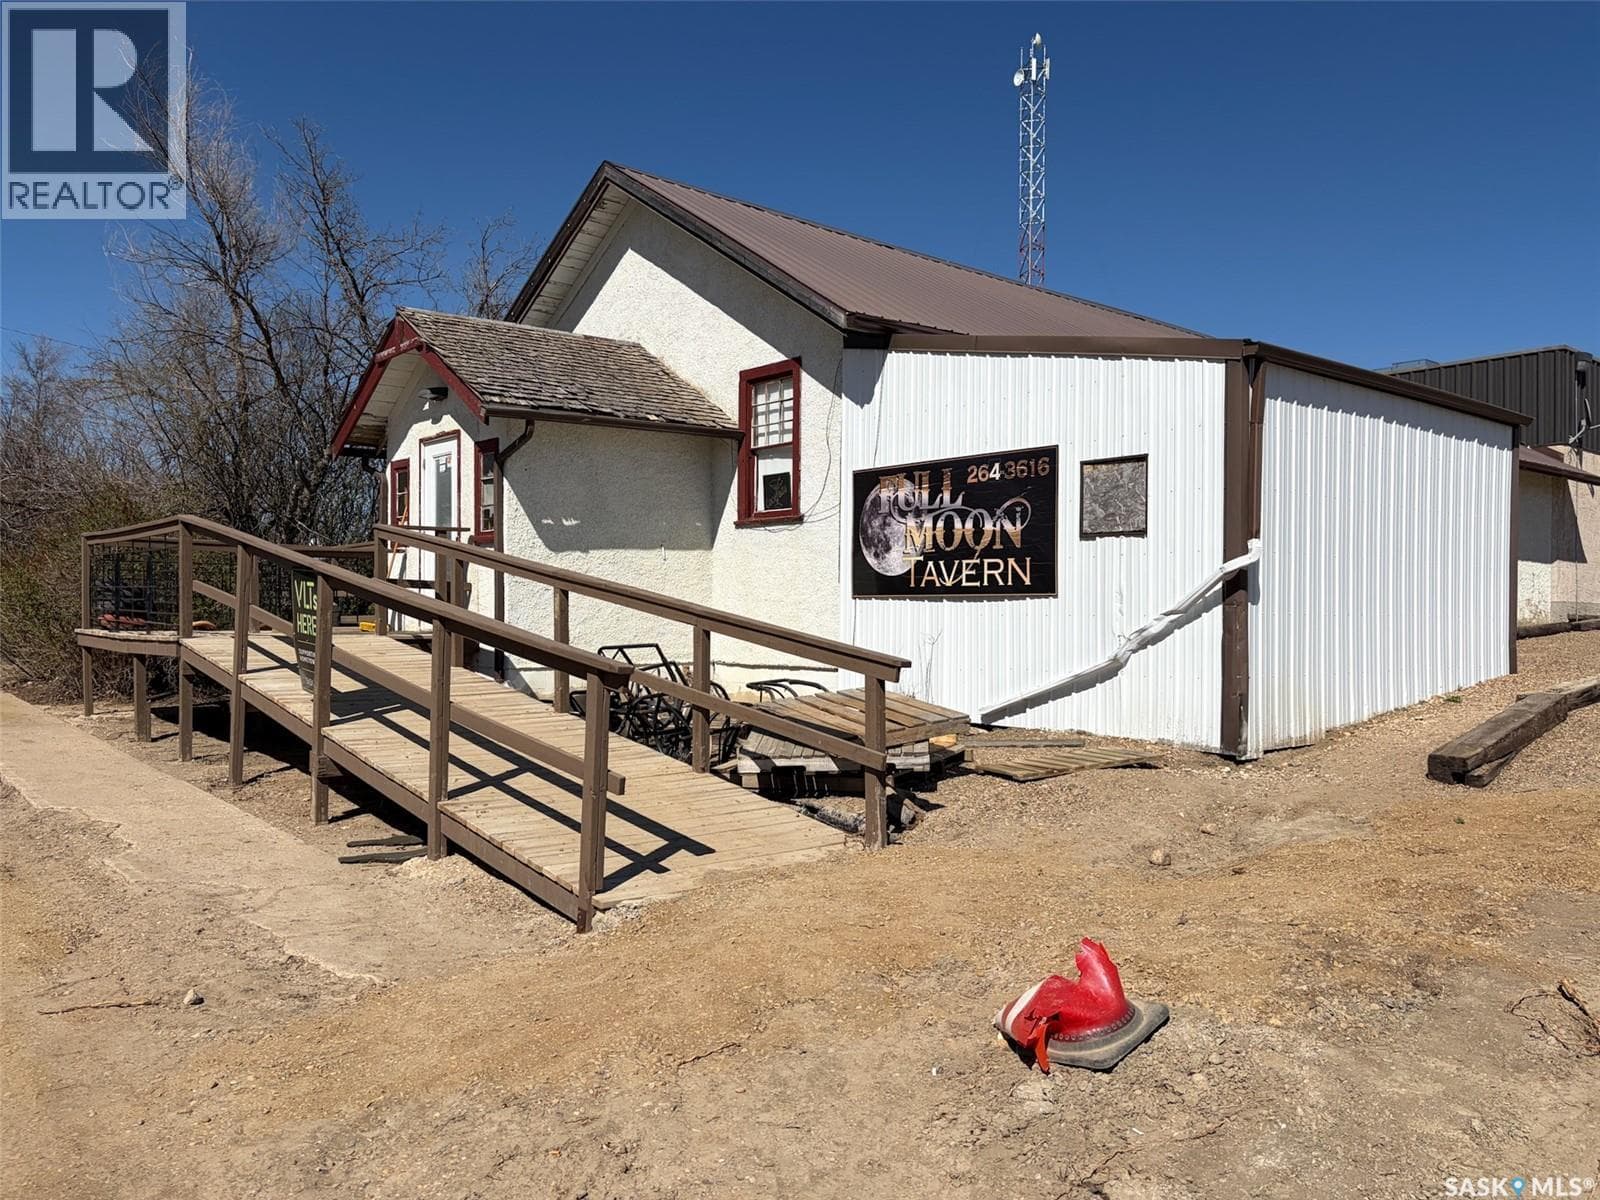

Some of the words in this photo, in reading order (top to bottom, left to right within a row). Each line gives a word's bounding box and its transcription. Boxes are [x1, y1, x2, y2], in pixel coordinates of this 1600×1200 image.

[967, 456, 1050, 485] 264-3616
[878, 468, 966, 514] FULL
[902, 505, 1024, 555] MOON
[902, 556, 1032, 587] TAVERN
[296, 612, 317, 636] HERE
